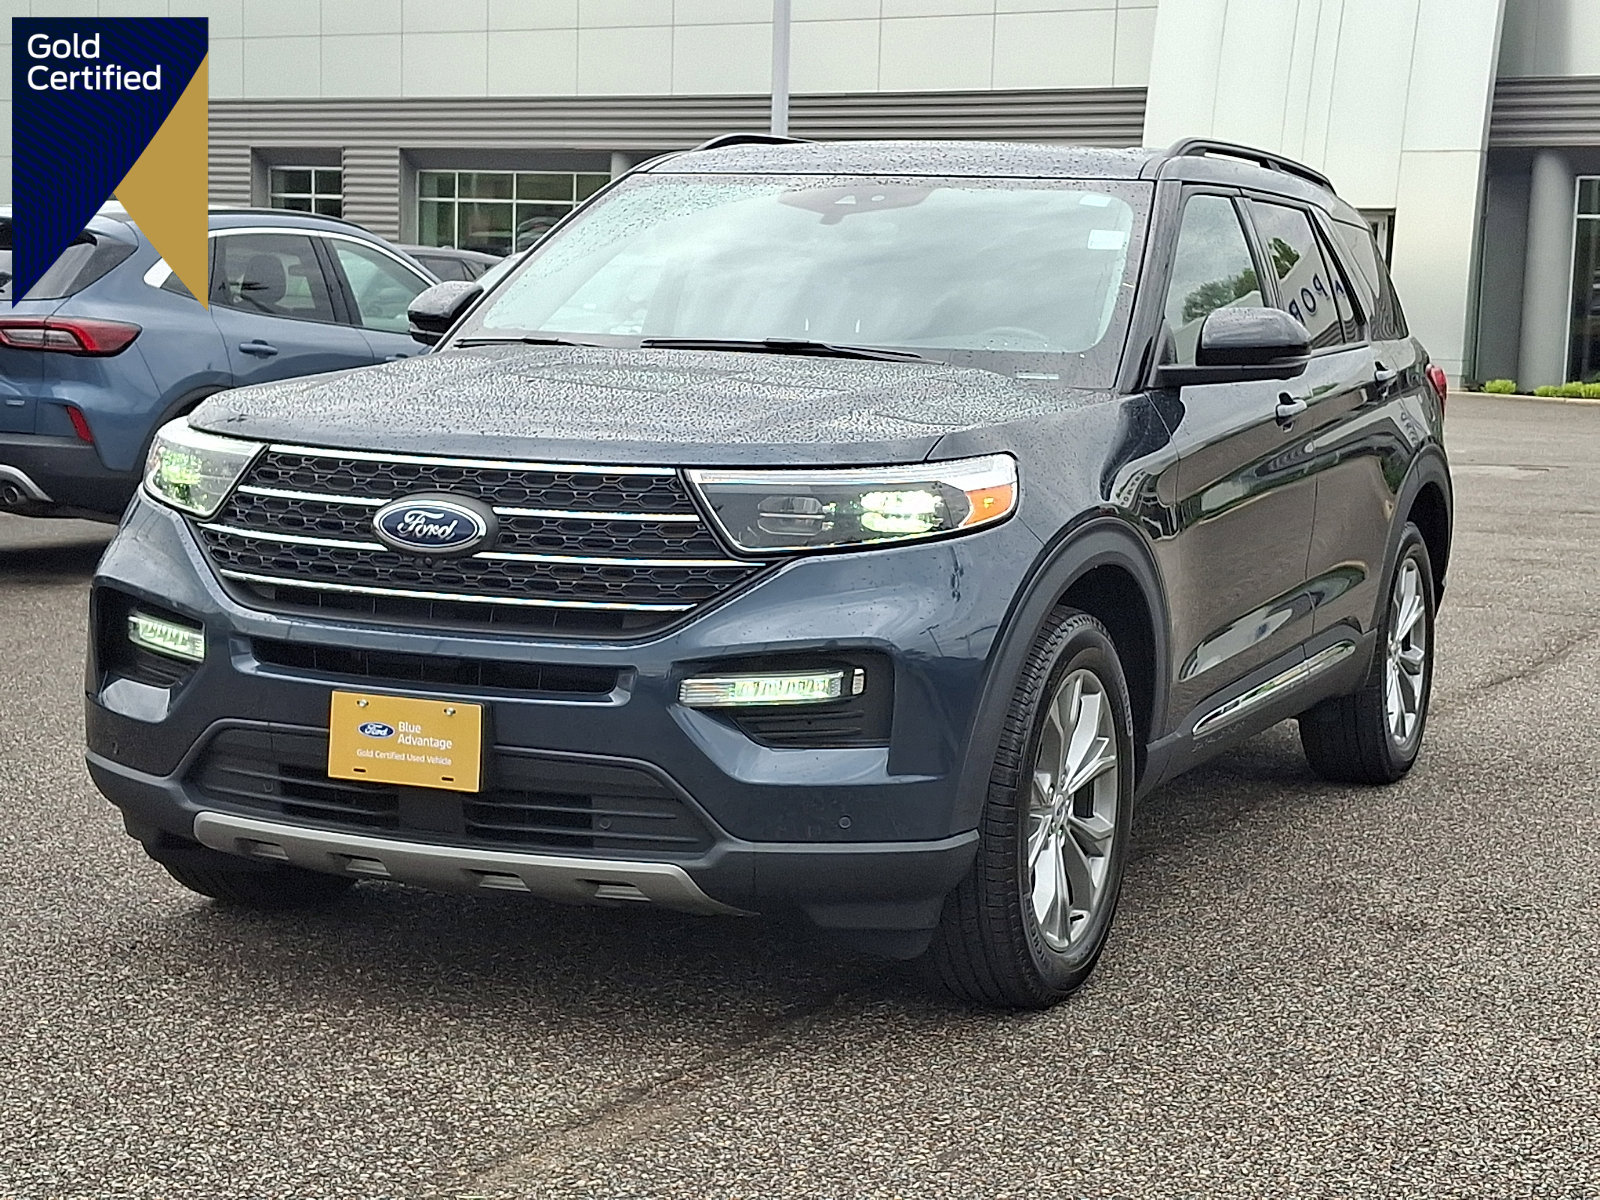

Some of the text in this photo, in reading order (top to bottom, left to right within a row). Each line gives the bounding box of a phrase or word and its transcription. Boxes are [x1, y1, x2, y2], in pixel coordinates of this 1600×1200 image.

[397, 509, 458, 540] Ford
[364, 722, 389, 736] Ford
[398, 721, 421, 733] Blue
[397, 733, 453, 750] Advantage
[356, 748, 452, 766] Gold Certified Used Vehicle
